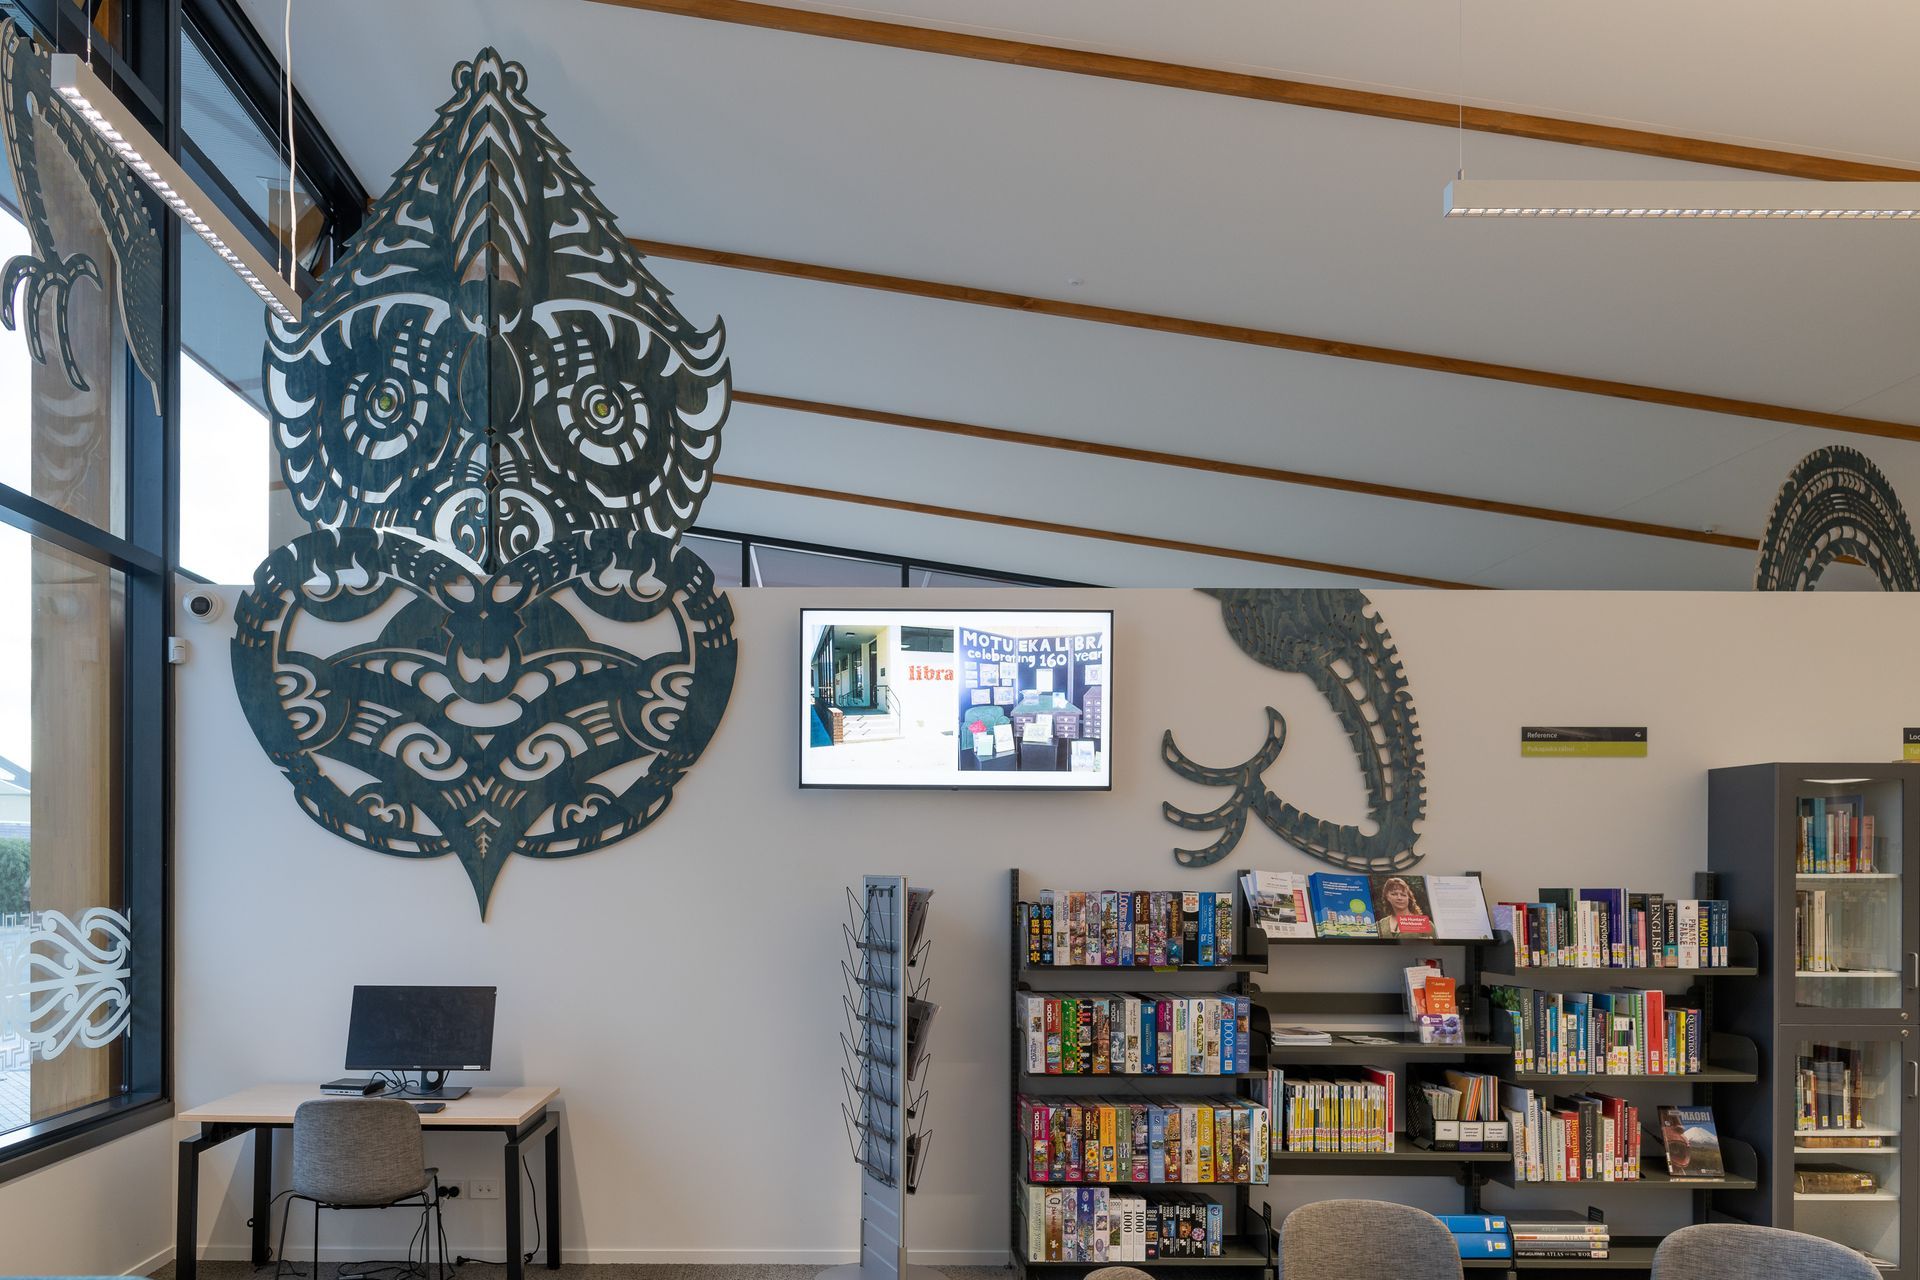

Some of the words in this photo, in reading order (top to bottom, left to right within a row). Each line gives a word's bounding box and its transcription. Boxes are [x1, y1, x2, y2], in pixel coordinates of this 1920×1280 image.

[908, 665, 954, 681] libra
[1040, 653, 1068, 668] 160
[1651, 904, 1661, 956] ENGLISH
[1688, 919, 1697, 946] PHRASE
[1699, 918, 1708, 947] MAORI
[1224, 1022, 1233, 1046] 1000
[1685, 1014, 1695, 1060] QUOTATIONS
[1570, 1119, 1580, 1160] Biographi
[1123, 1211, 1132, 1233] 1000
[1135, 1211, 1144, 1233] 1000
